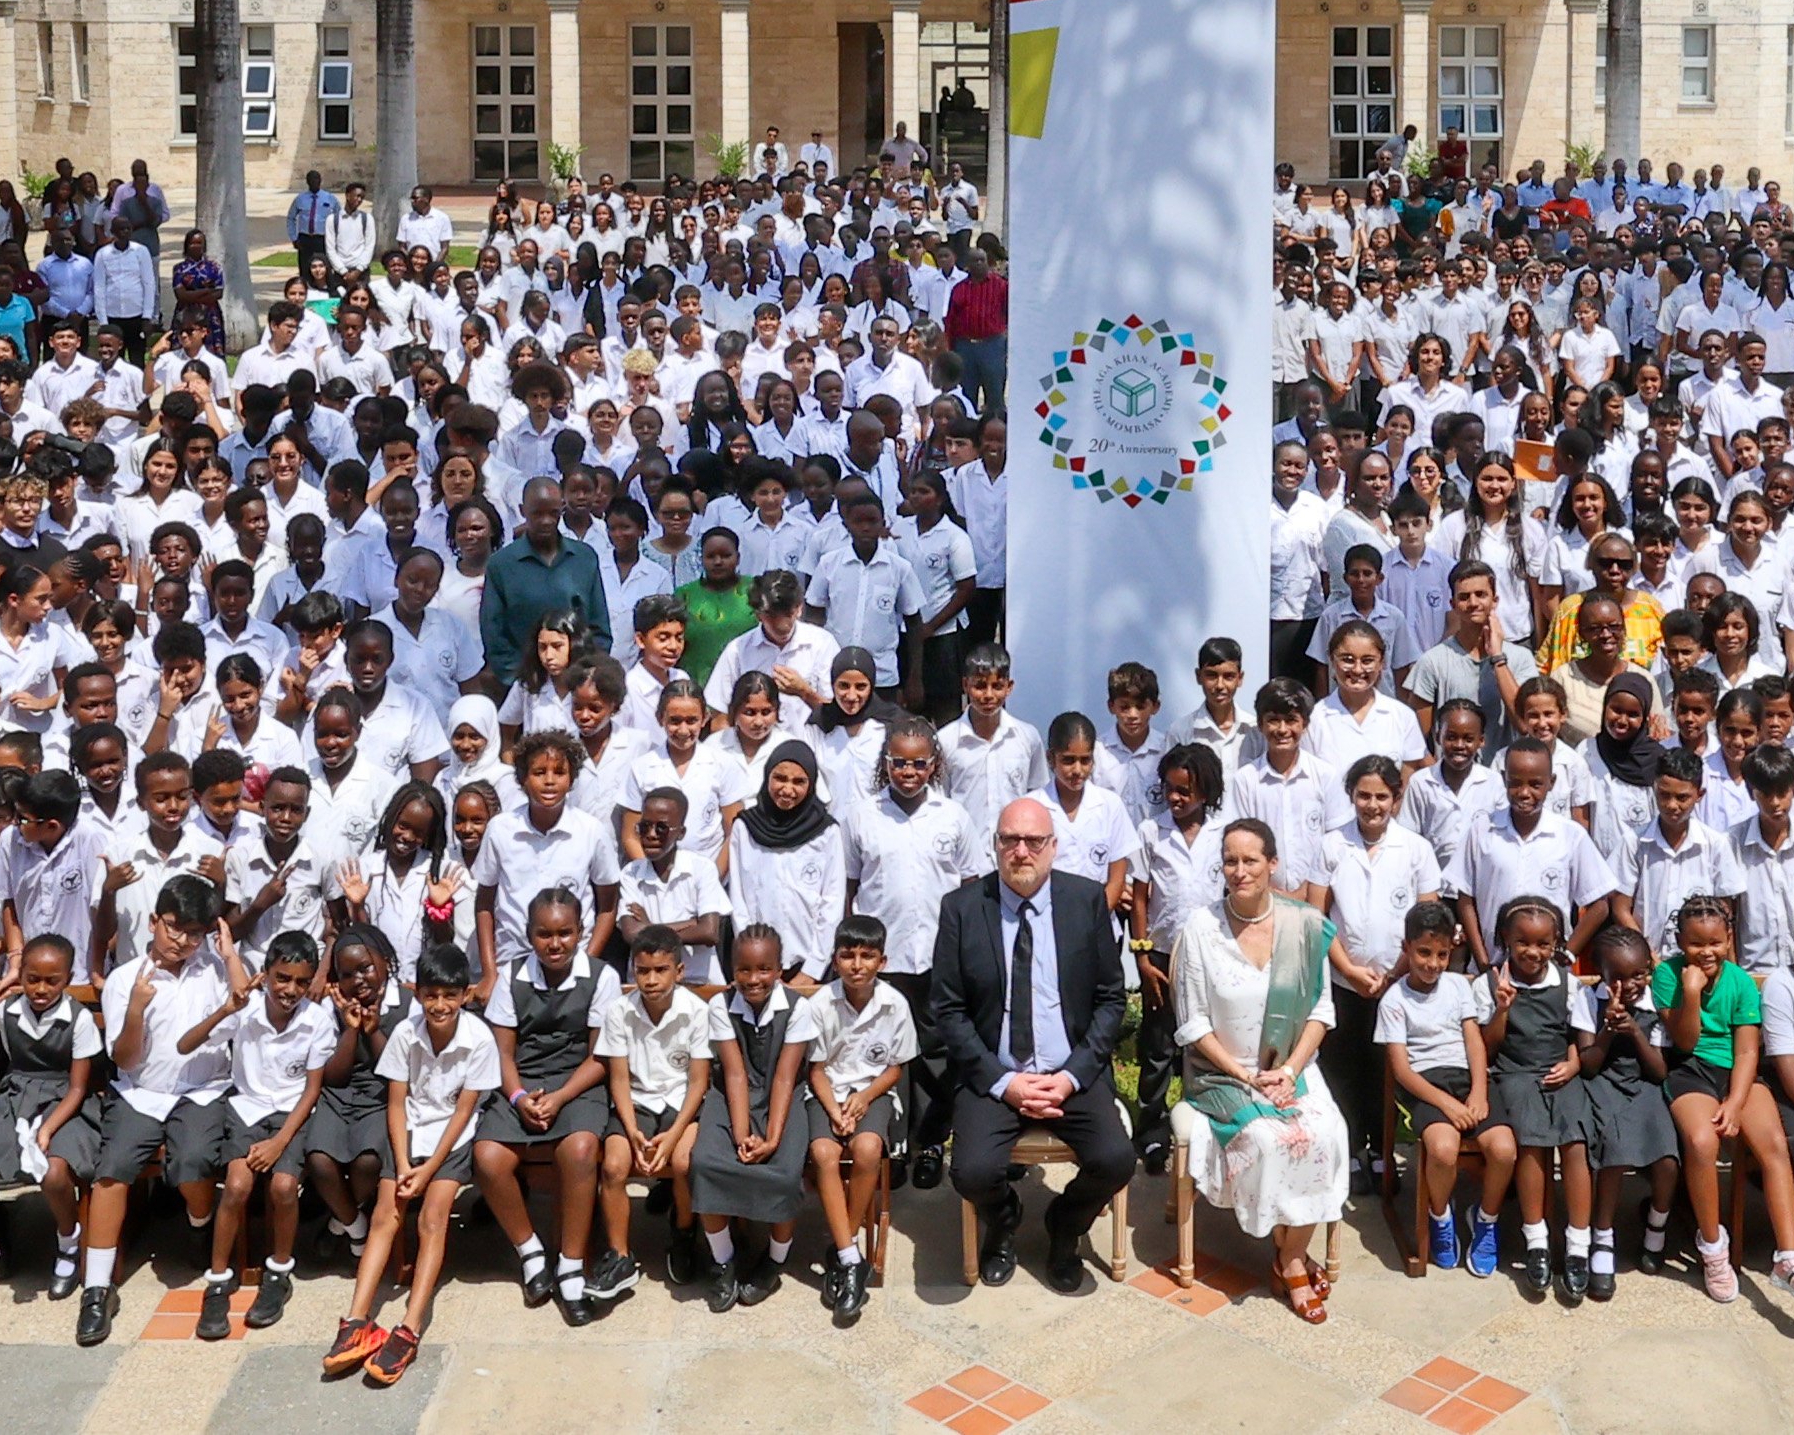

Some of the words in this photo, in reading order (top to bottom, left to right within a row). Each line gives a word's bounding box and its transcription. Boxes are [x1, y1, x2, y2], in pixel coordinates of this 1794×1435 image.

[1113, 354, 1149, 366] KHAN
[1096, 365, 1113, 383] AGA
[1150, 362, 1174, 414] ACADEMY
[1093, 388, 1104, 413] THE
[1106, 416, 1162, 434] MOMBASA
[1116, 443, 1178, 457] Anniversary
